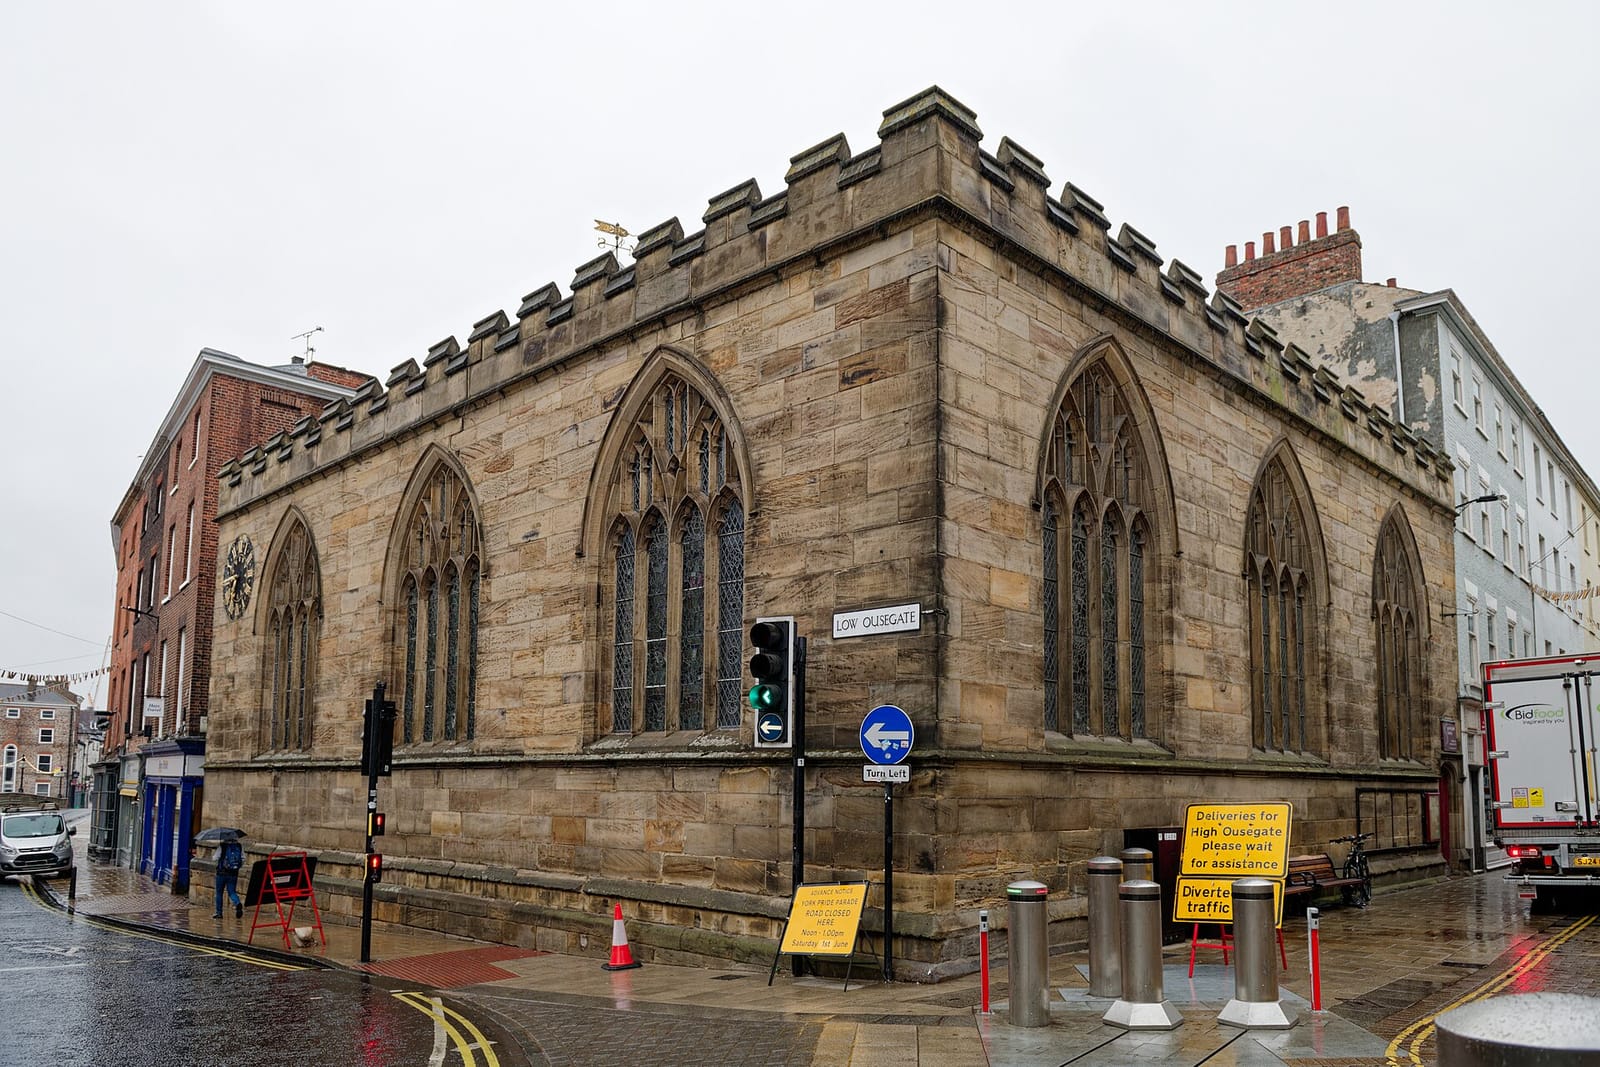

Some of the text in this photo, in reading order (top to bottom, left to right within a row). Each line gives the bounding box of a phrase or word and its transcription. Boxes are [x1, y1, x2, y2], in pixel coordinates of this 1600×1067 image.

[836, 611, 916, 632] LOW OUSEGATE
[1514, 708, 1564, 720] Bidfood
[1196, 812, 1278, 820] Deliveries for
[1191, 827, 1282, 838] High Ousegate
[1202, 841, 1272, 851] please wait
[1191, 858, 1278, 869] for assistance
[1183, 886, 1232, 897] Diverte
[1188, 901, 1230, 913] traffic
[792, 939, 817, 948] Saturday
